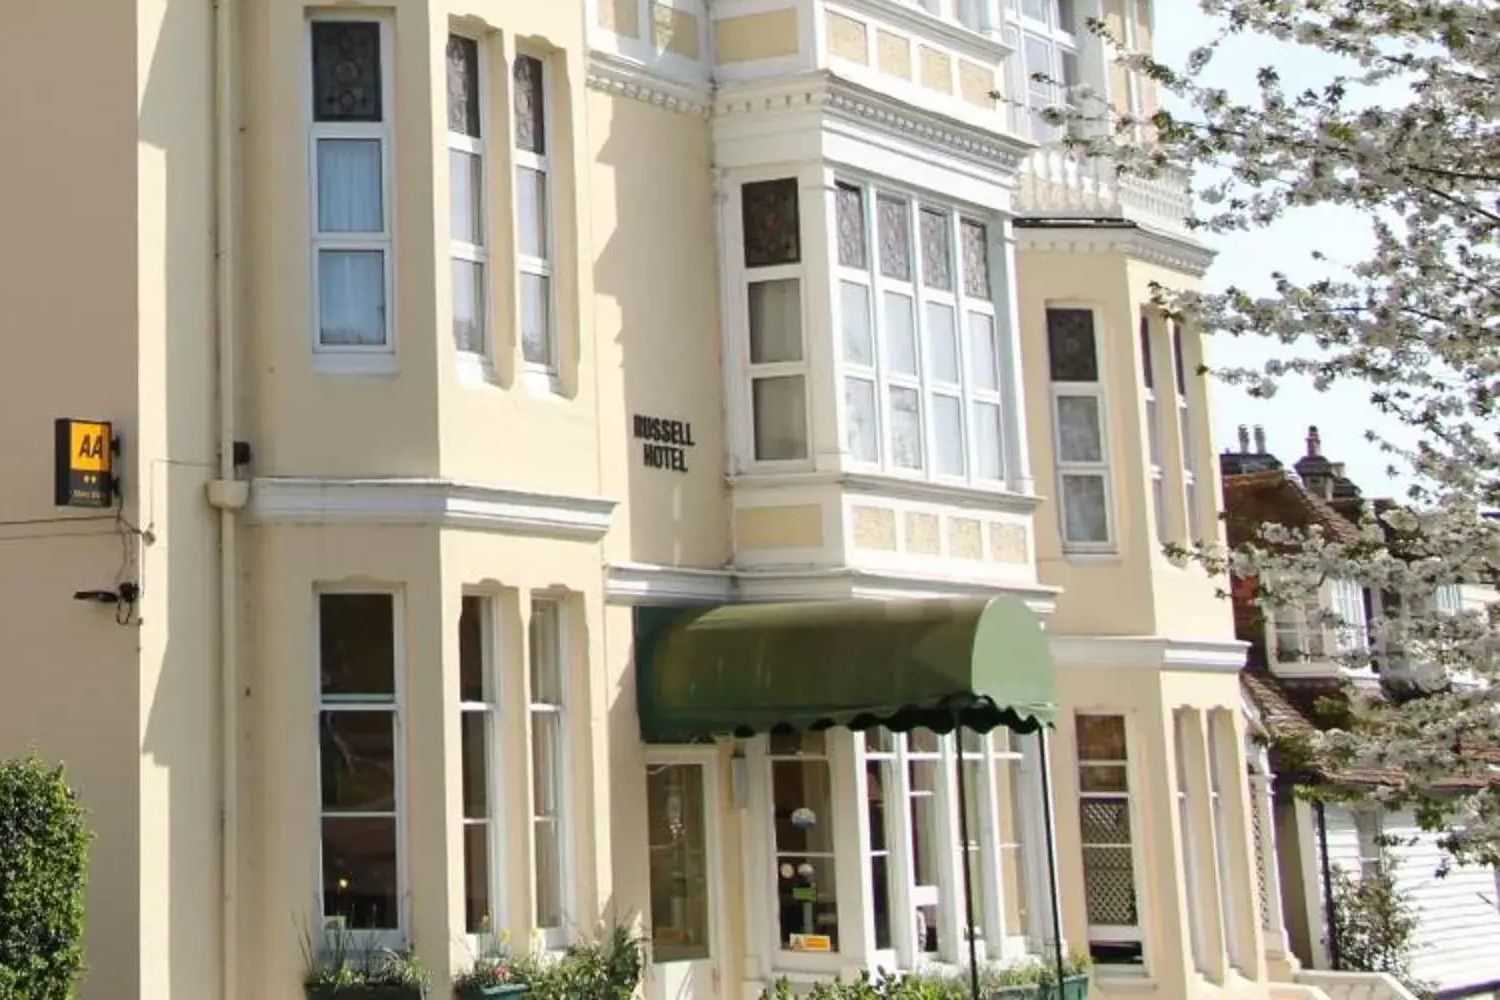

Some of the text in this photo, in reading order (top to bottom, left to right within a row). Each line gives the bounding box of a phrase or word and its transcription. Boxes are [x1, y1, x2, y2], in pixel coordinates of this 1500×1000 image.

[633, 415, 696, 446] RUSSELL
[79, 434, 104, 459] AA
[643, 443, 689, 473] HOTEL
